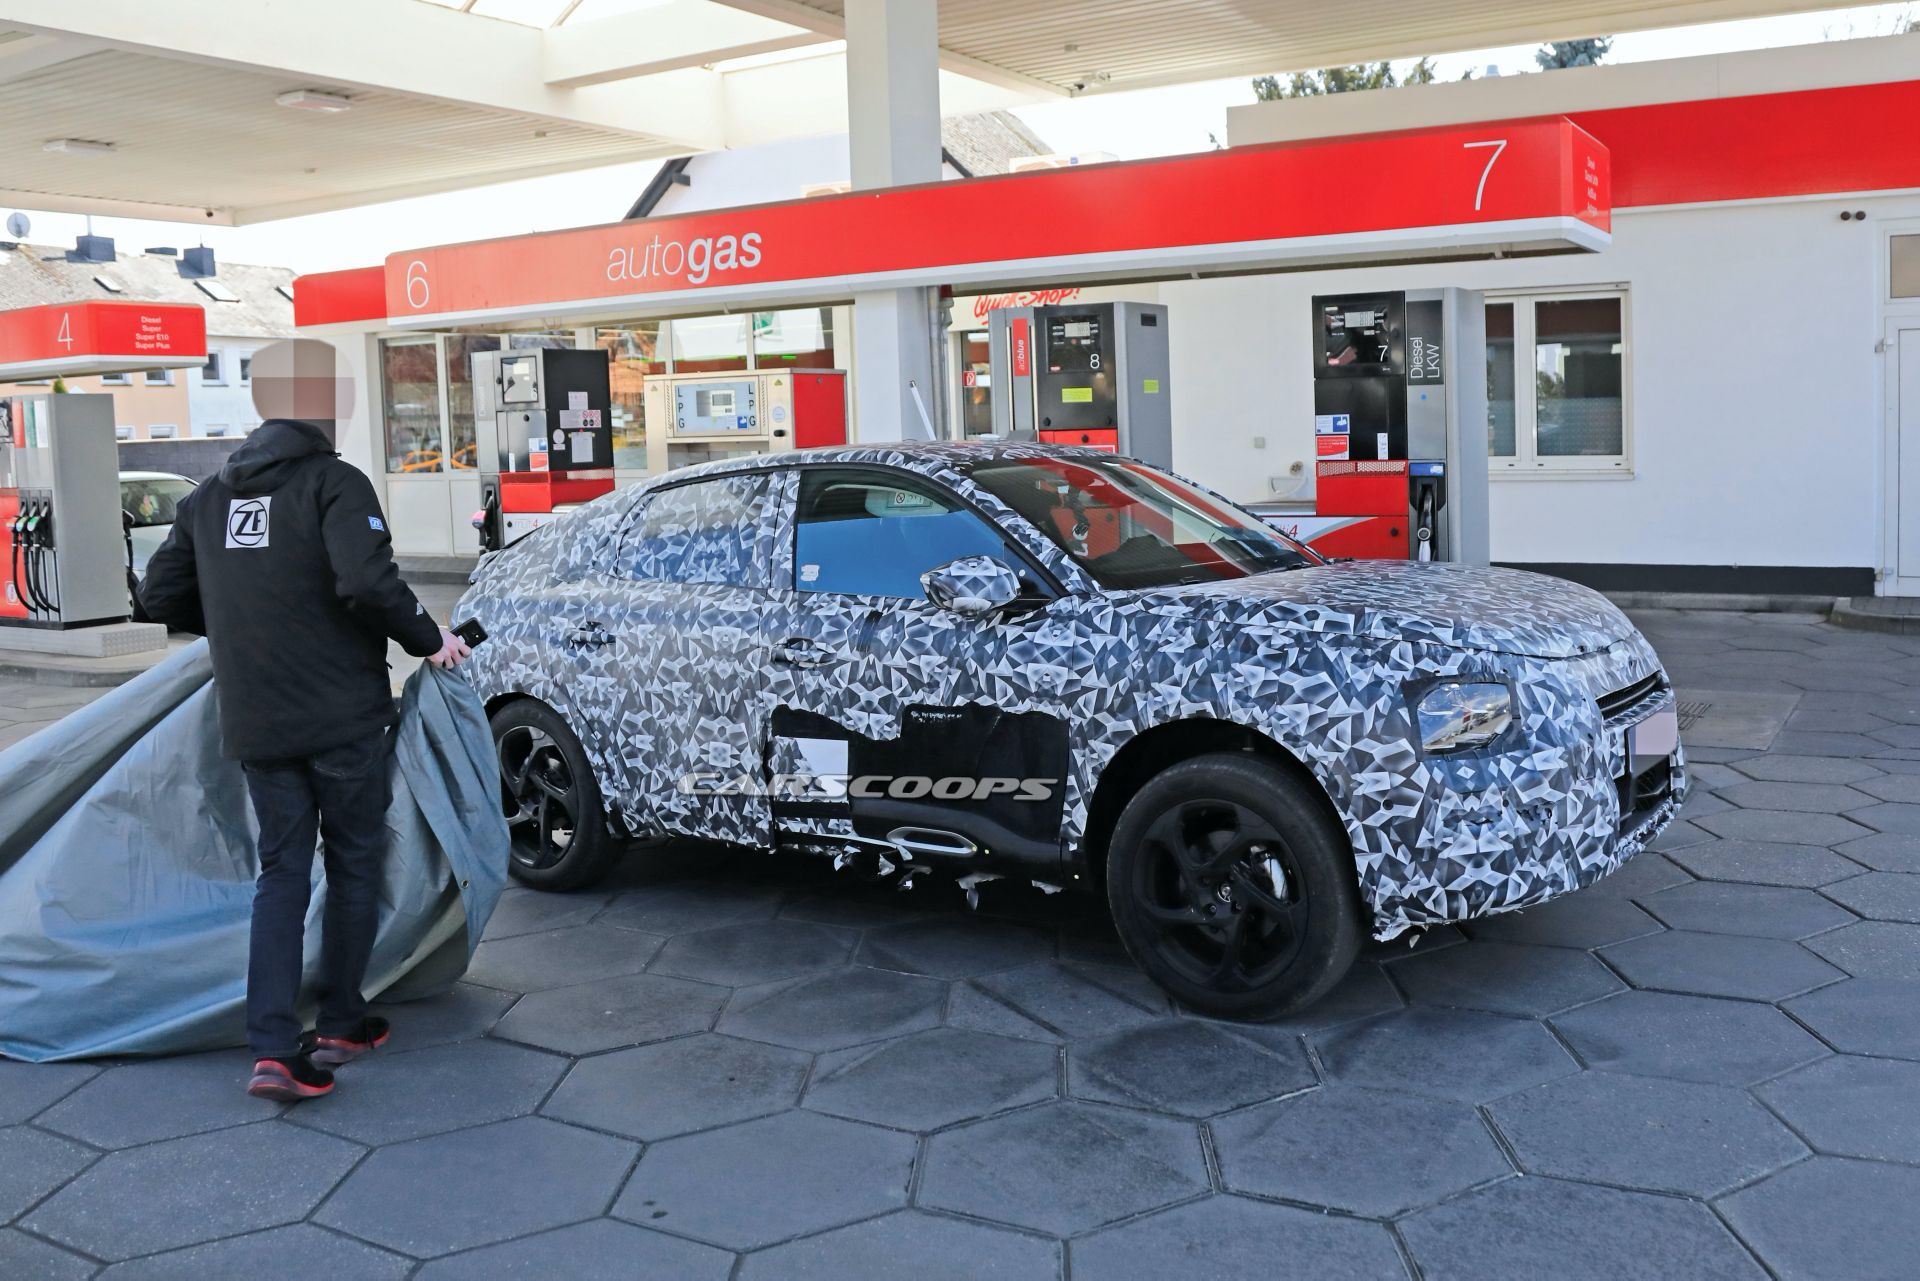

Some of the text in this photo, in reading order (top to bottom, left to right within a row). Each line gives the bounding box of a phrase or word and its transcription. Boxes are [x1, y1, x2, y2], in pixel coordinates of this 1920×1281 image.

[1463, 139, 1508, 211] 7
[607, 232, 762, 284] autogas
[406, 260, 429, 309] 6
[57, 312, 74, 351] 4
[1090, 353, 1100, 369] 8
[1377, 345, 1388, 362] 7
[1409, 337, 1423, 379] Diesel
[1426, 343, 1440, 378] LKW
[233, 506, 267, 537] ZF
